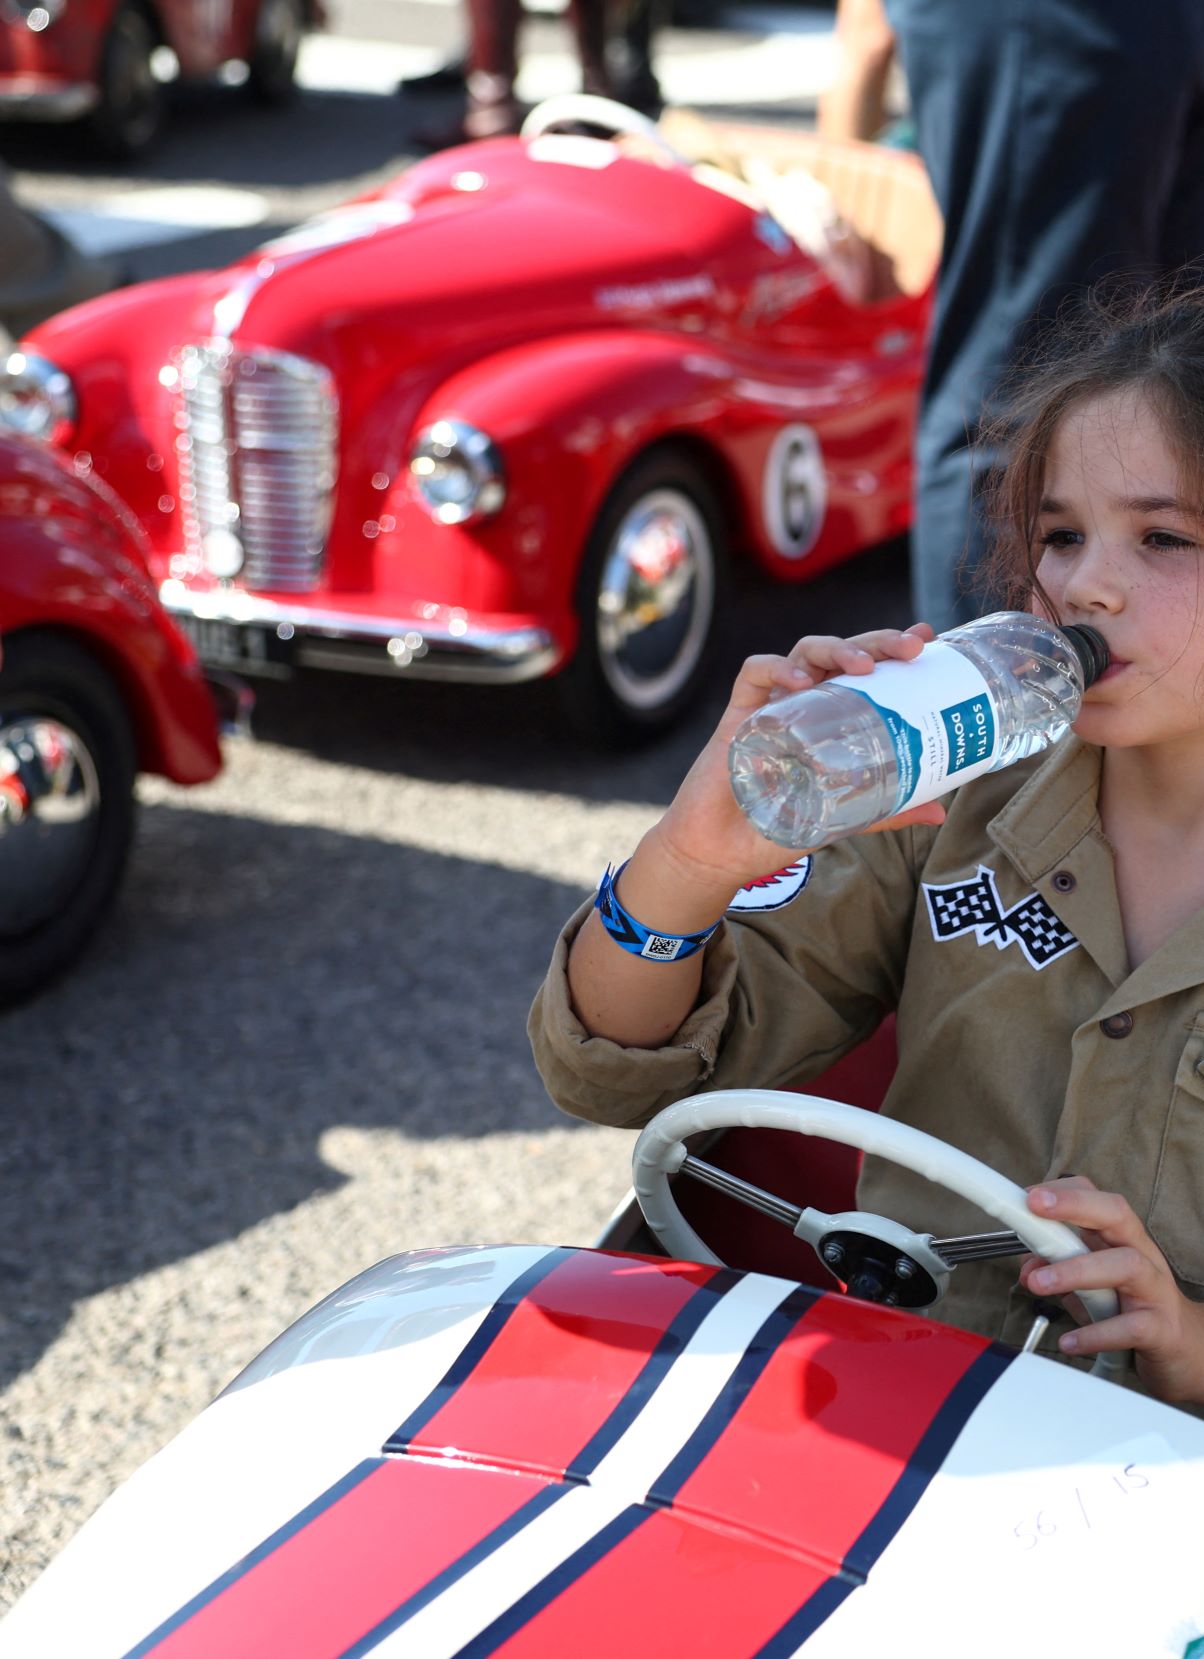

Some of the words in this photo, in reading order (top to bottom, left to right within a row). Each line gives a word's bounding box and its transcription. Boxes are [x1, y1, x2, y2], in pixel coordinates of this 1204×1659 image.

[782, 440, 814, 541] 6
[928, 736, 936, 766] STILL
[973, 703, 987, 757] SOUTH
